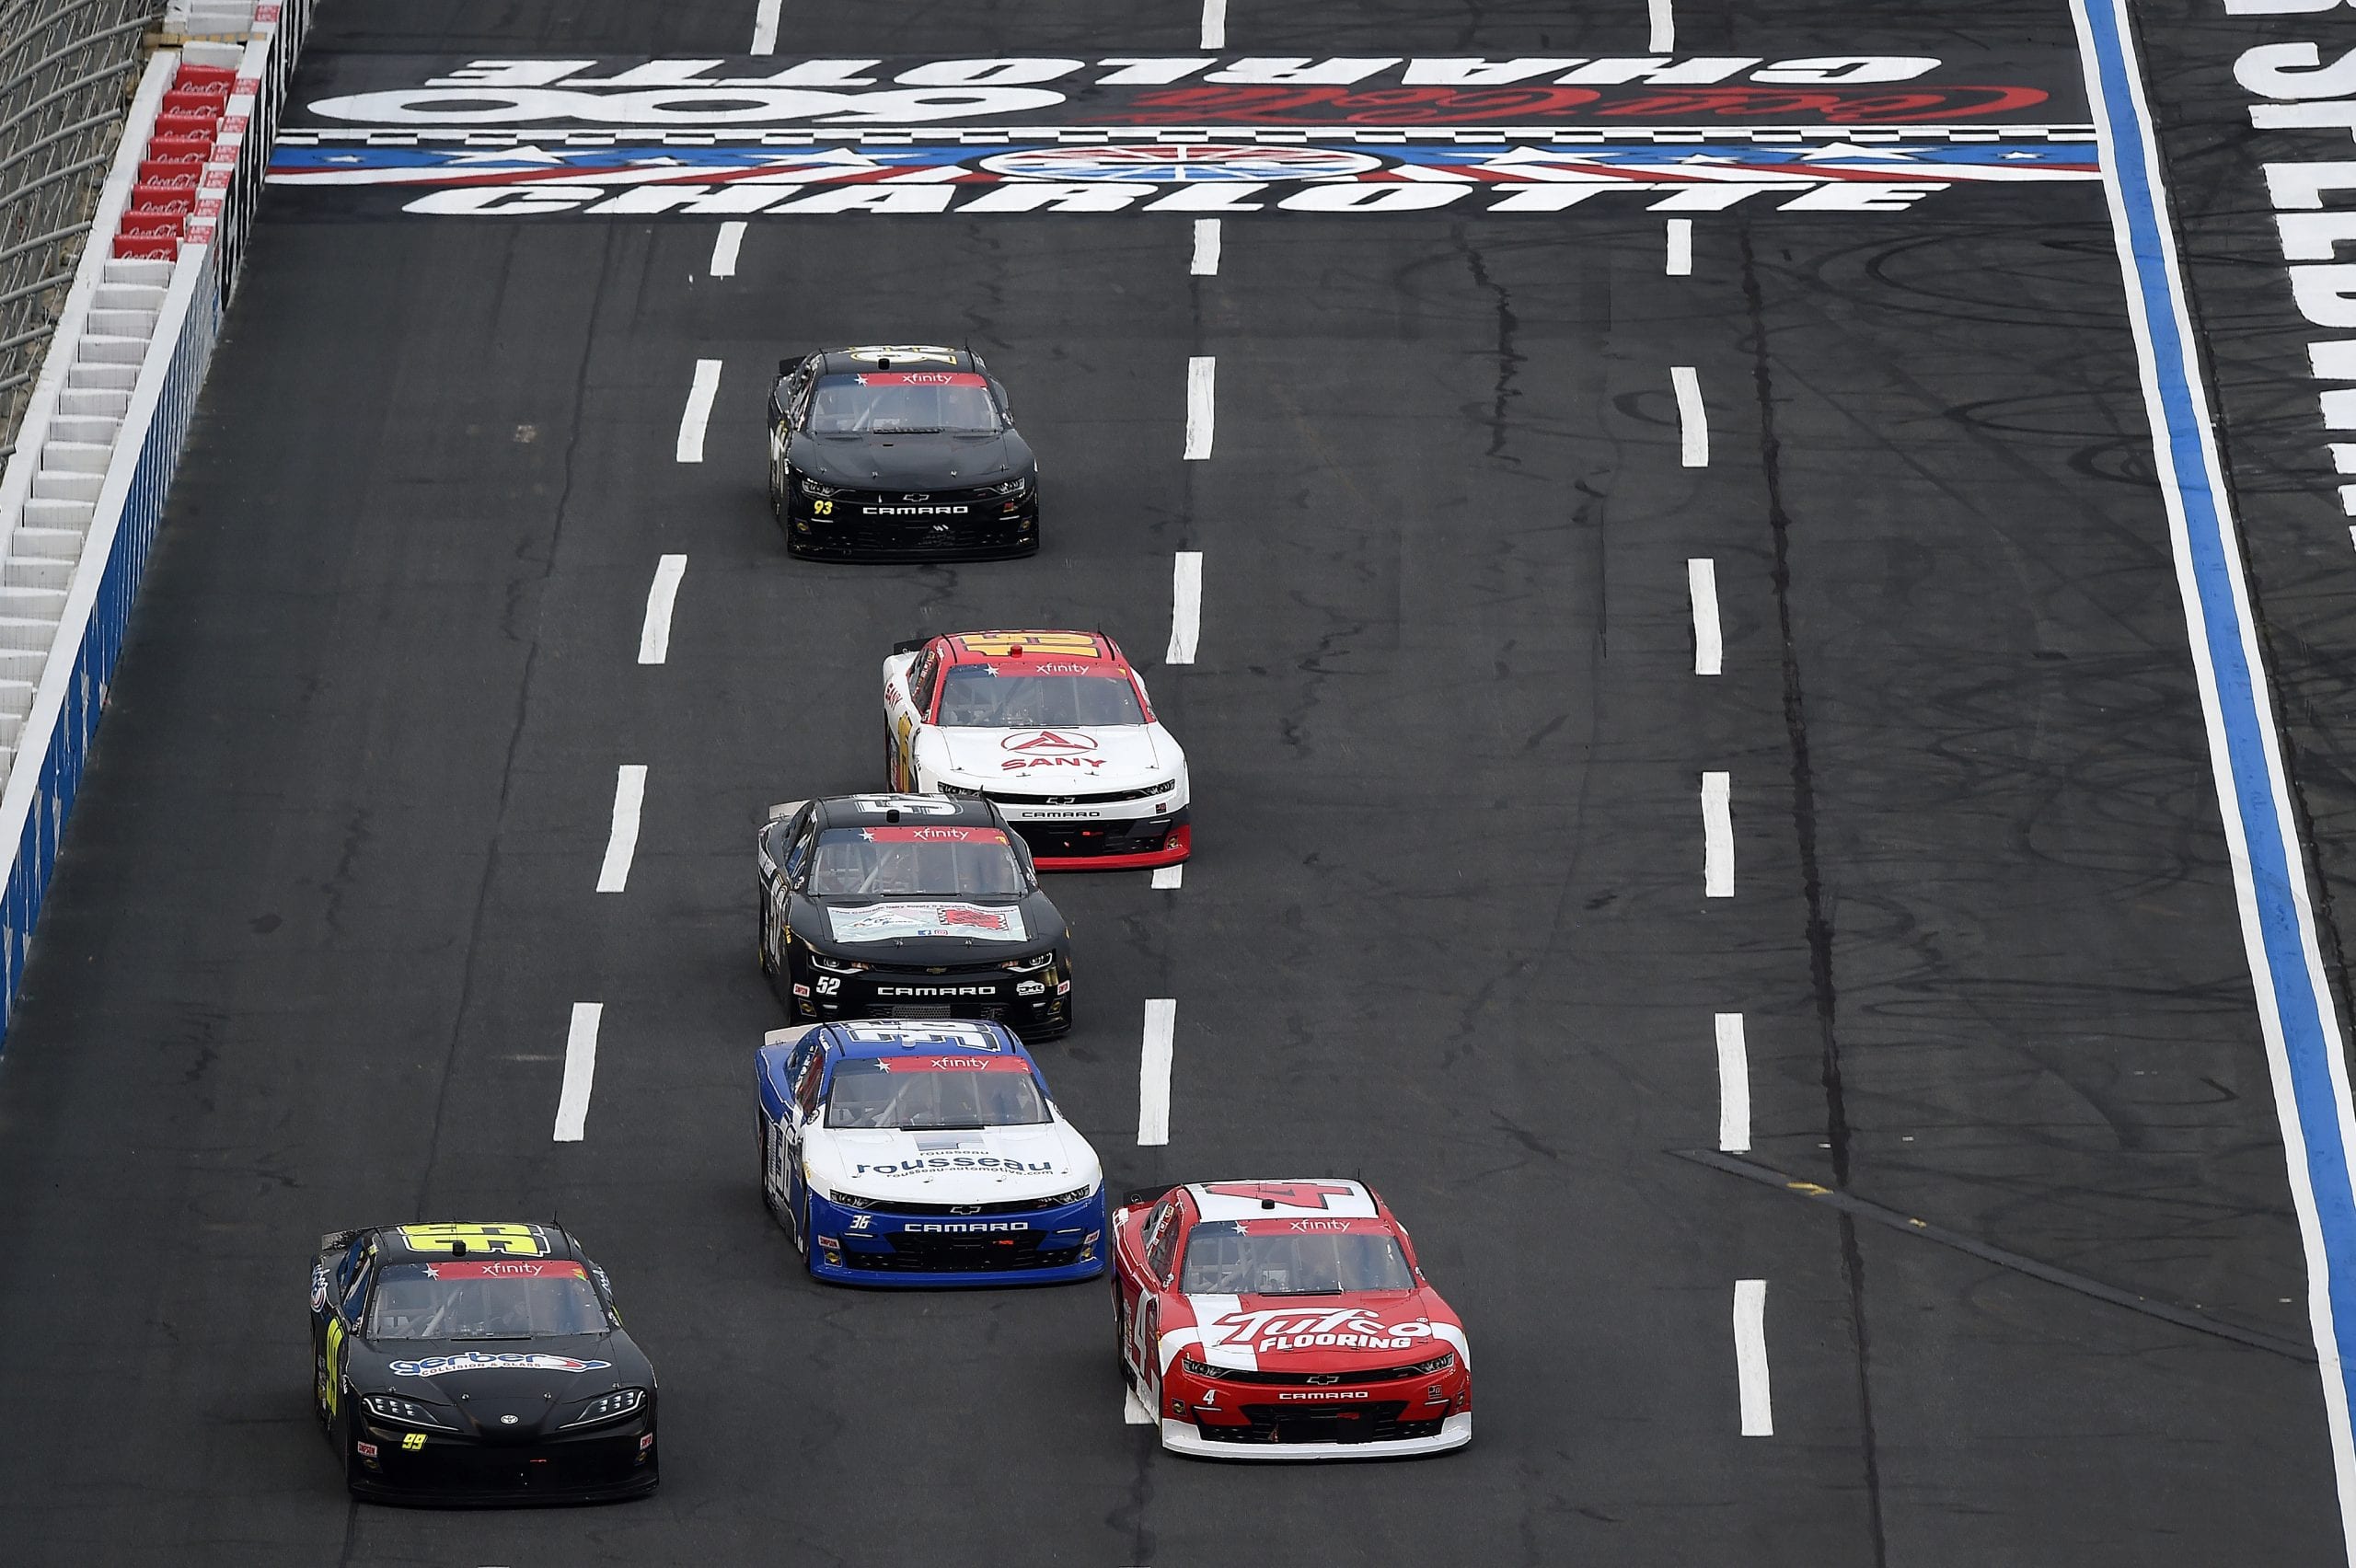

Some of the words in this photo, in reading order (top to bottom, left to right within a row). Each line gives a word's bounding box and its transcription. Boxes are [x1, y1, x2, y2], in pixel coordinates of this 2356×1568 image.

[426, 57, 1942, 86] CHARLOTTE
[307, 87, 1068, 123] 600
[1112, 86, 2049, 123] Coca-Cola
[402, 183, 1949, 214] CHARLOTTE
[902, 373, 953, 384] xfinity
[814, 501, 833, 515] 93
[862, 506, 968, 515] CAMARO
[1035, 663, 1090, 674] xfinity
[1001, 757, 1107, 770] SANY
[913, 828, 970, 840] xfinity
[815, 975, 841, 995] 52
[877, 986, 997, 996] CAMARO
[930, 1057, 989, 1069] xfinity
[856, 1157, 1052, 1174] rousseau
[849, 1215, 872, 1229] 36
[904, 1222, 1029, 1232] CAMARO
[1289, 1218, 1352, 1232] xfinity
[482, 1262, 543, 1275] xfinity
[1224, 1307, 1432, 1343] Tufco
[1258, 1333, 1412, 1353] FLOORING
[390, 1352, 547, 1374] gerber
[422, 1363, 486, 1377] COLLISION
[1202, 1389, 1216, 1404] 4
[1278, 1391, 1369, 1400] CAMARO
[402, 1433, 427, 1450] 99
